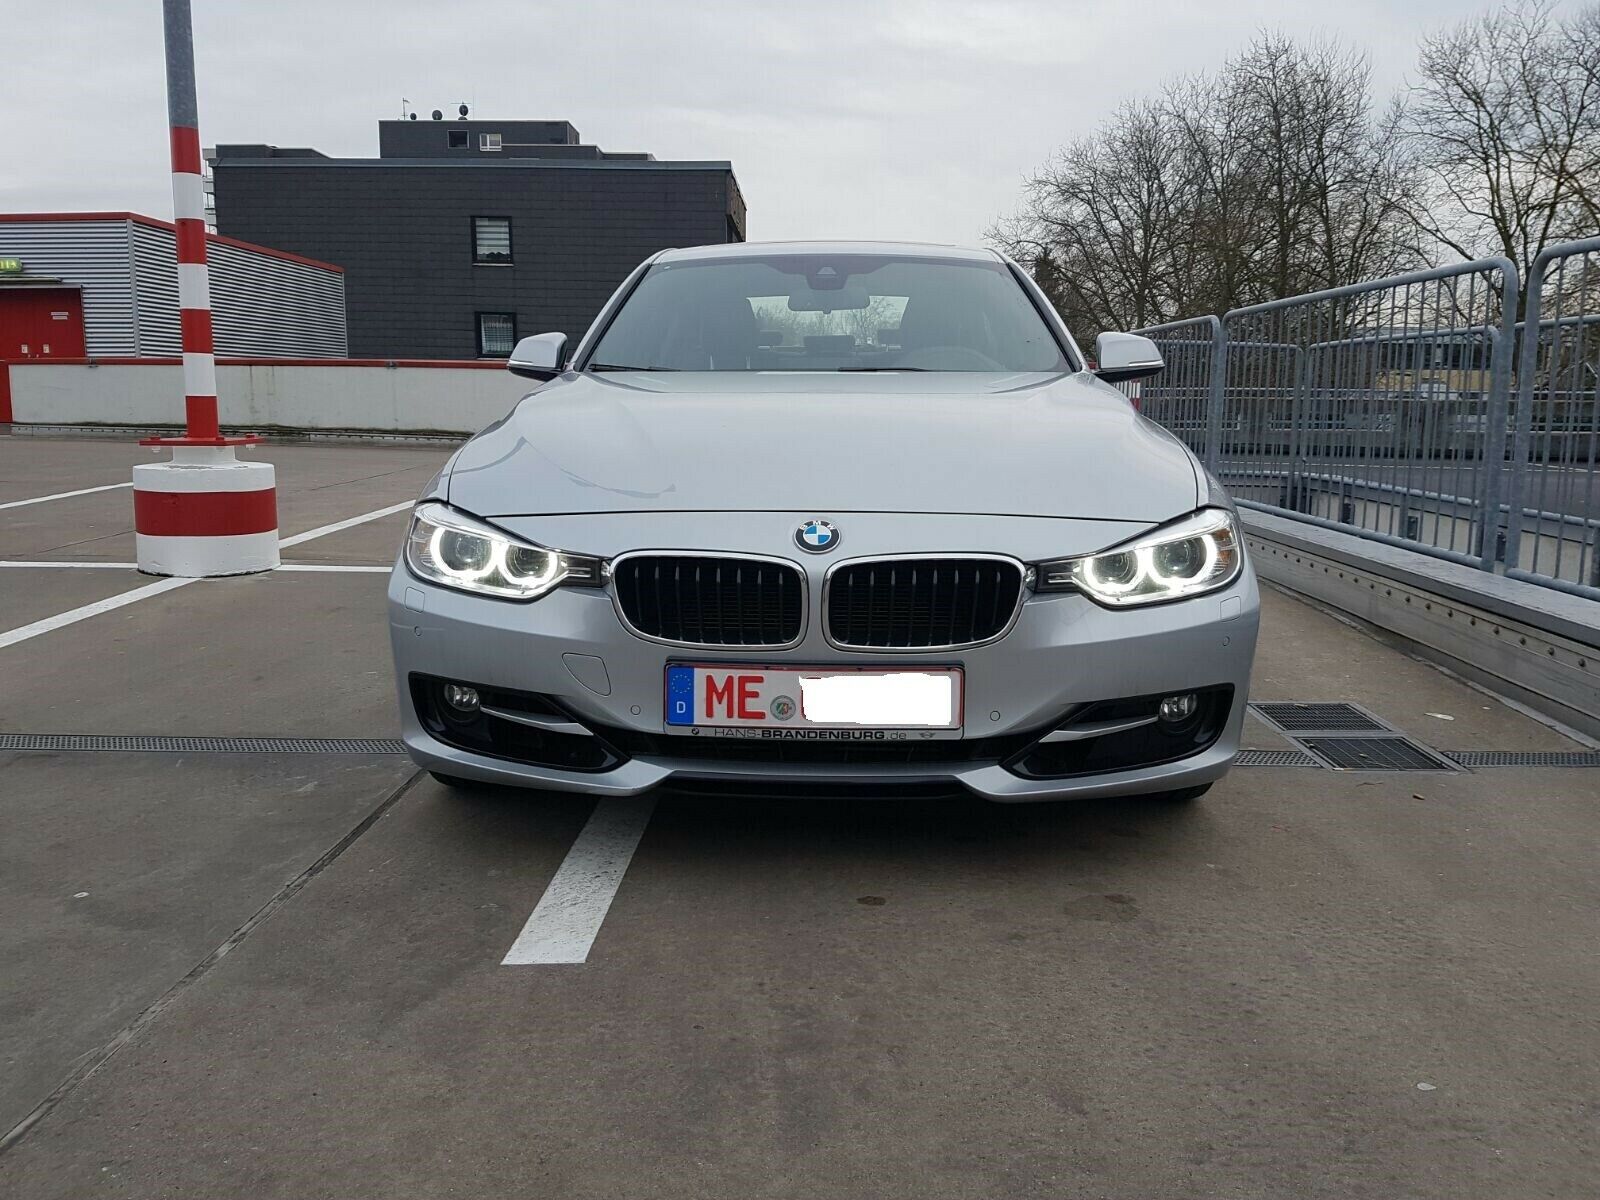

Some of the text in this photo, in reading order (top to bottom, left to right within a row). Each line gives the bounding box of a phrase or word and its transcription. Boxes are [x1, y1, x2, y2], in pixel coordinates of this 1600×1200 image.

[706, 674, 766, 719] ME
[676, 701, 686, 714] D
[714, 727, 907, 741] HANS-BRANDENBURG.de
